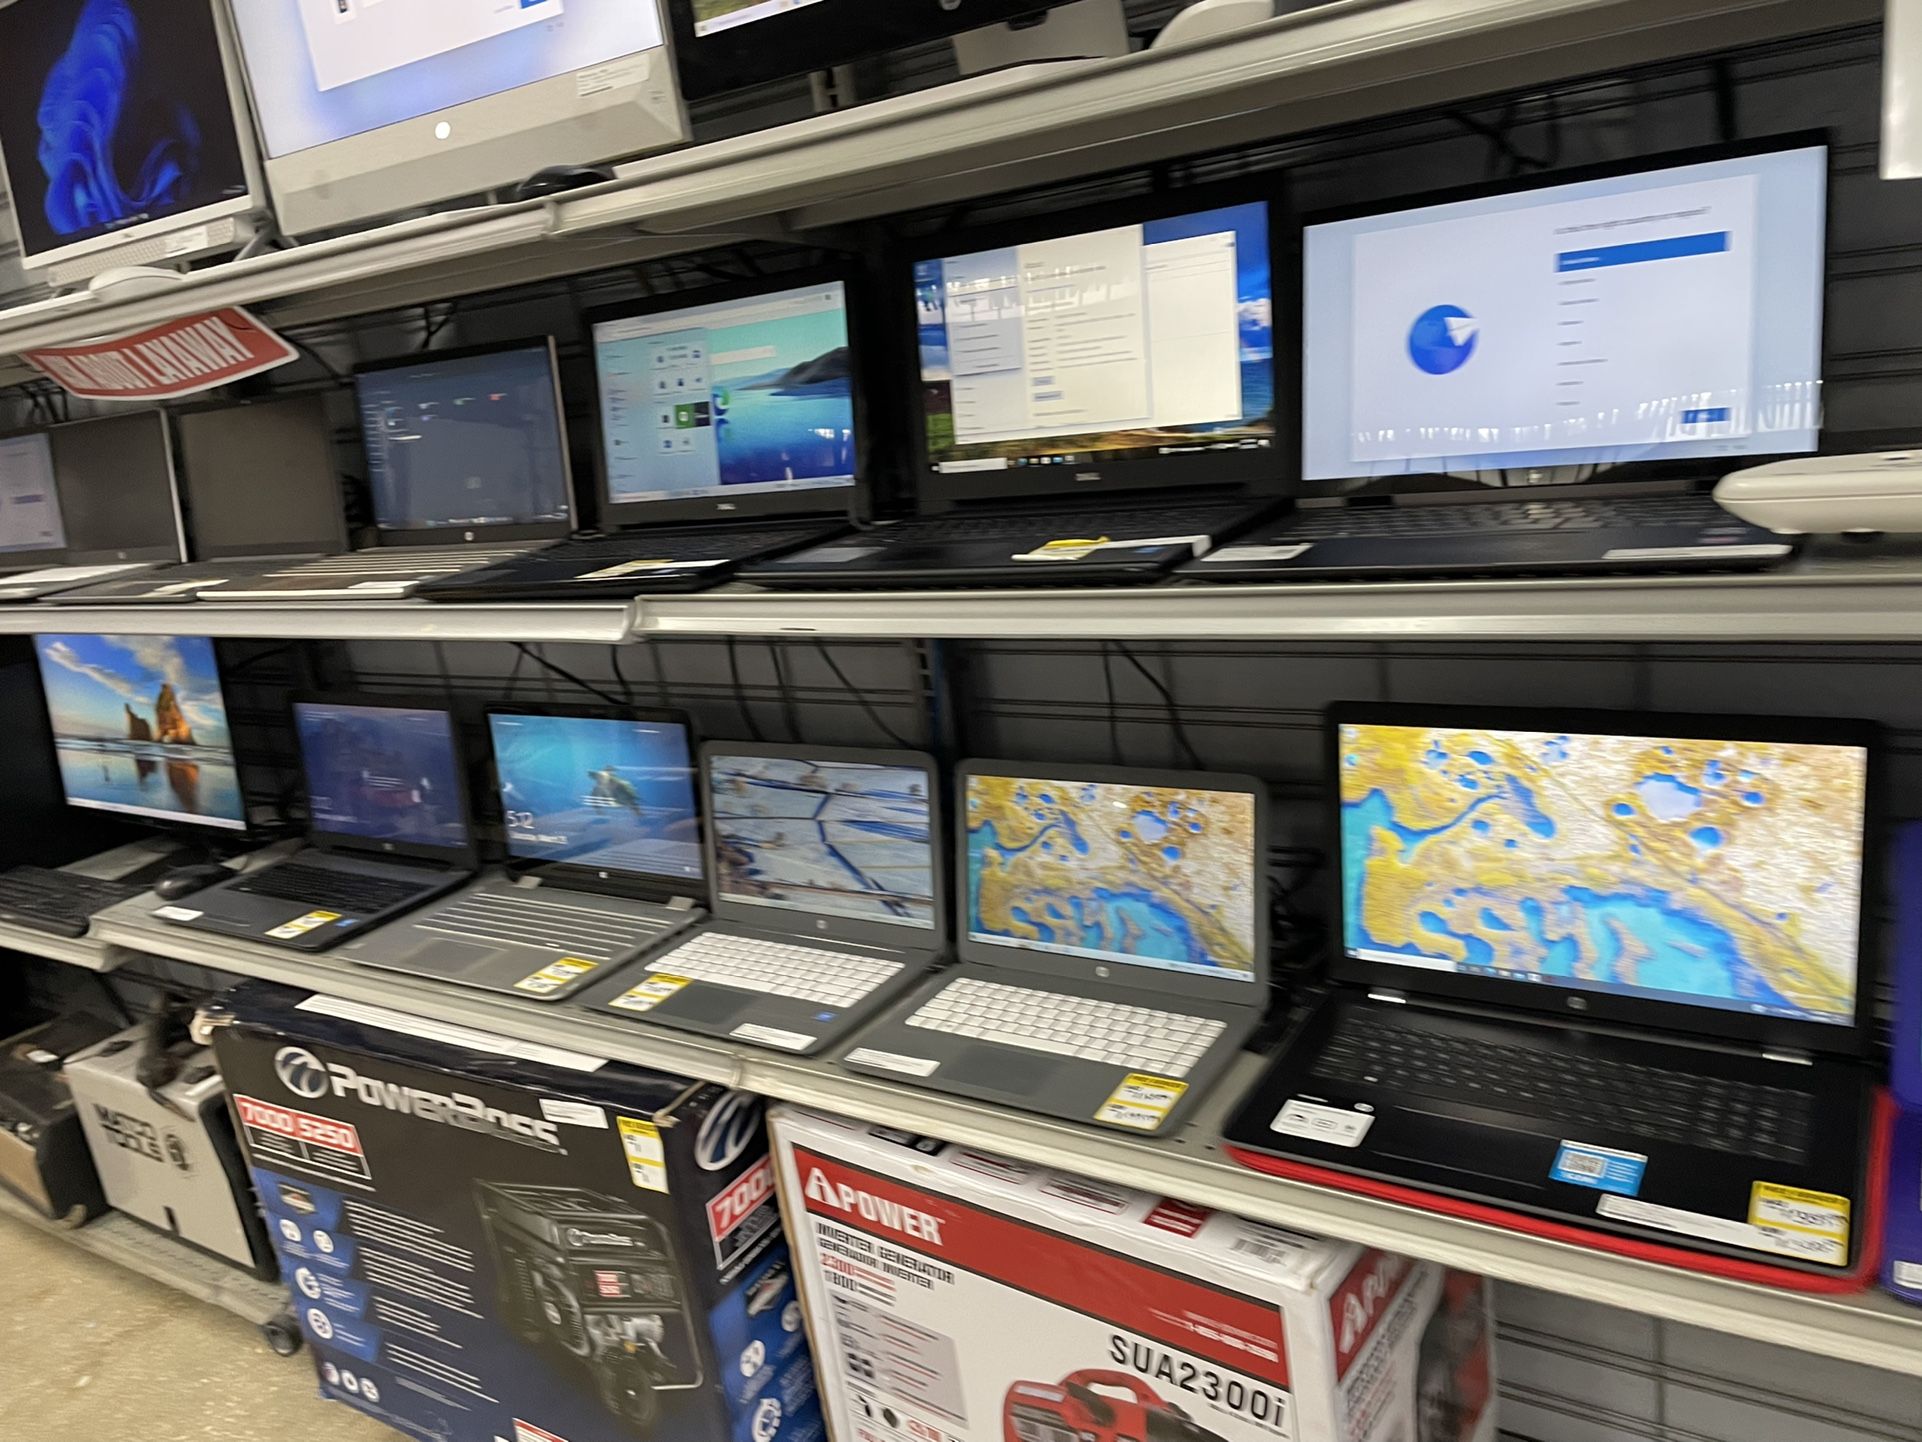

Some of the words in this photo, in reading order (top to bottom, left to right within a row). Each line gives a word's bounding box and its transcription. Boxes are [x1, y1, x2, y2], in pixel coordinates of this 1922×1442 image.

[120, 316, 255, 386] LAYAWAY
[241, 1102, 295, 1133] 7000
[298, 1117, 355, 1150] 5250
[1109, 1334, 1287, 1429] SUA2300i
